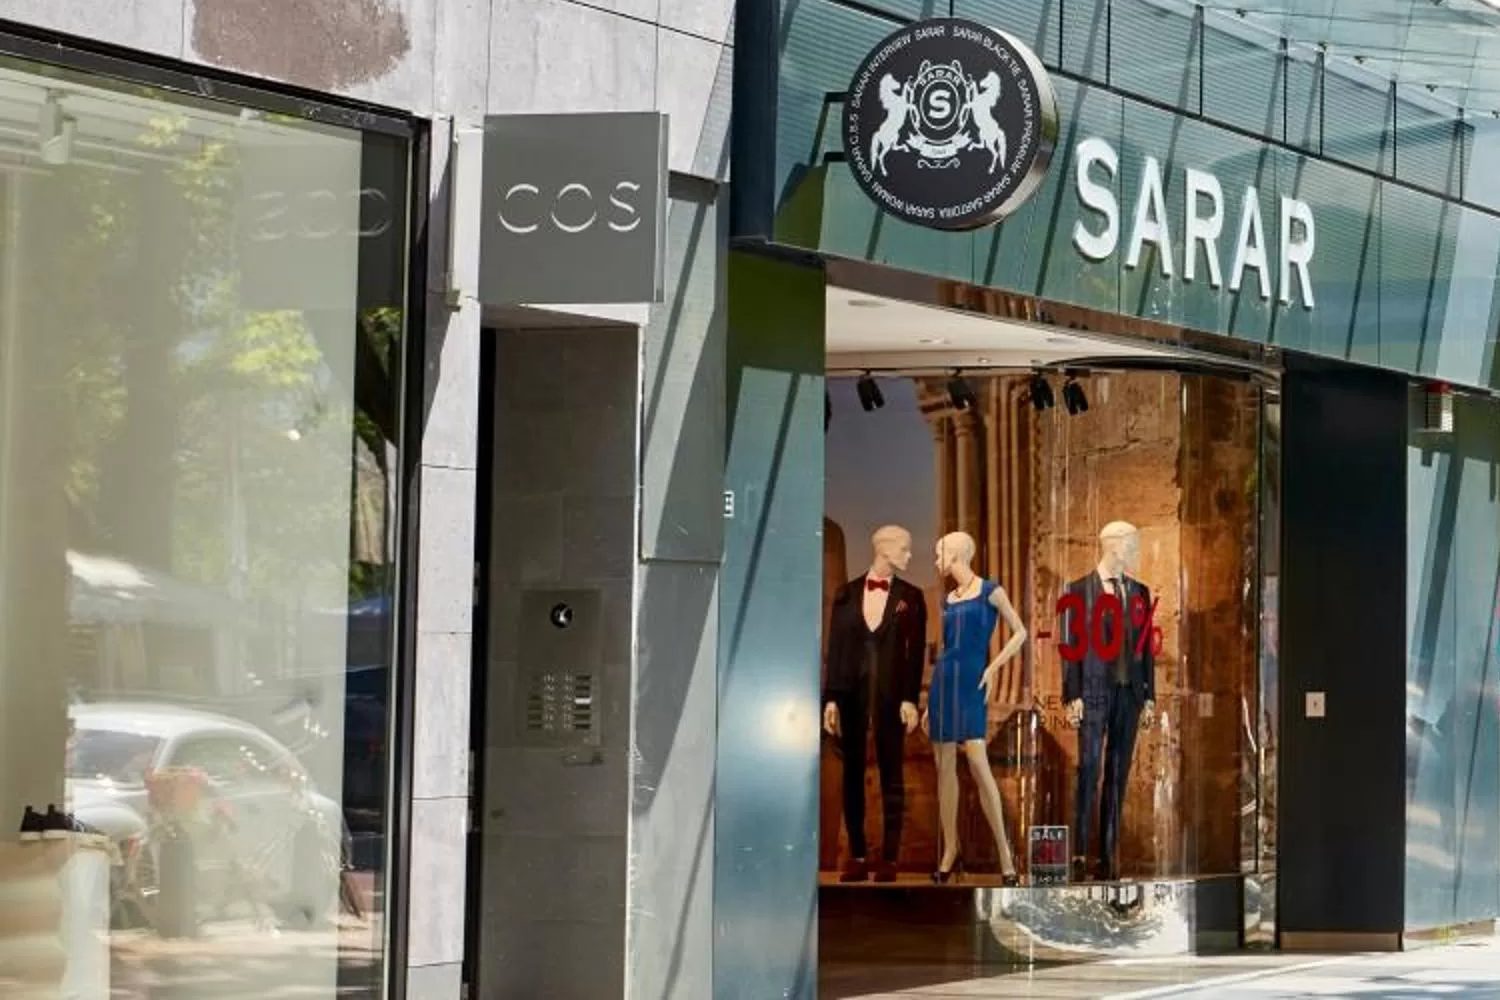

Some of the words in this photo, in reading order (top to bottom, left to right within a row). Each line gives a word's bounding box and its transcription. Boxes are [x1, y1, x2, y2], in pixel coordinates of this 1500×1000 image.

[929, 89, 951, 118] S
[499, 181, 640, 233] COS
[1071, 137, 1315, 310] SARAR
